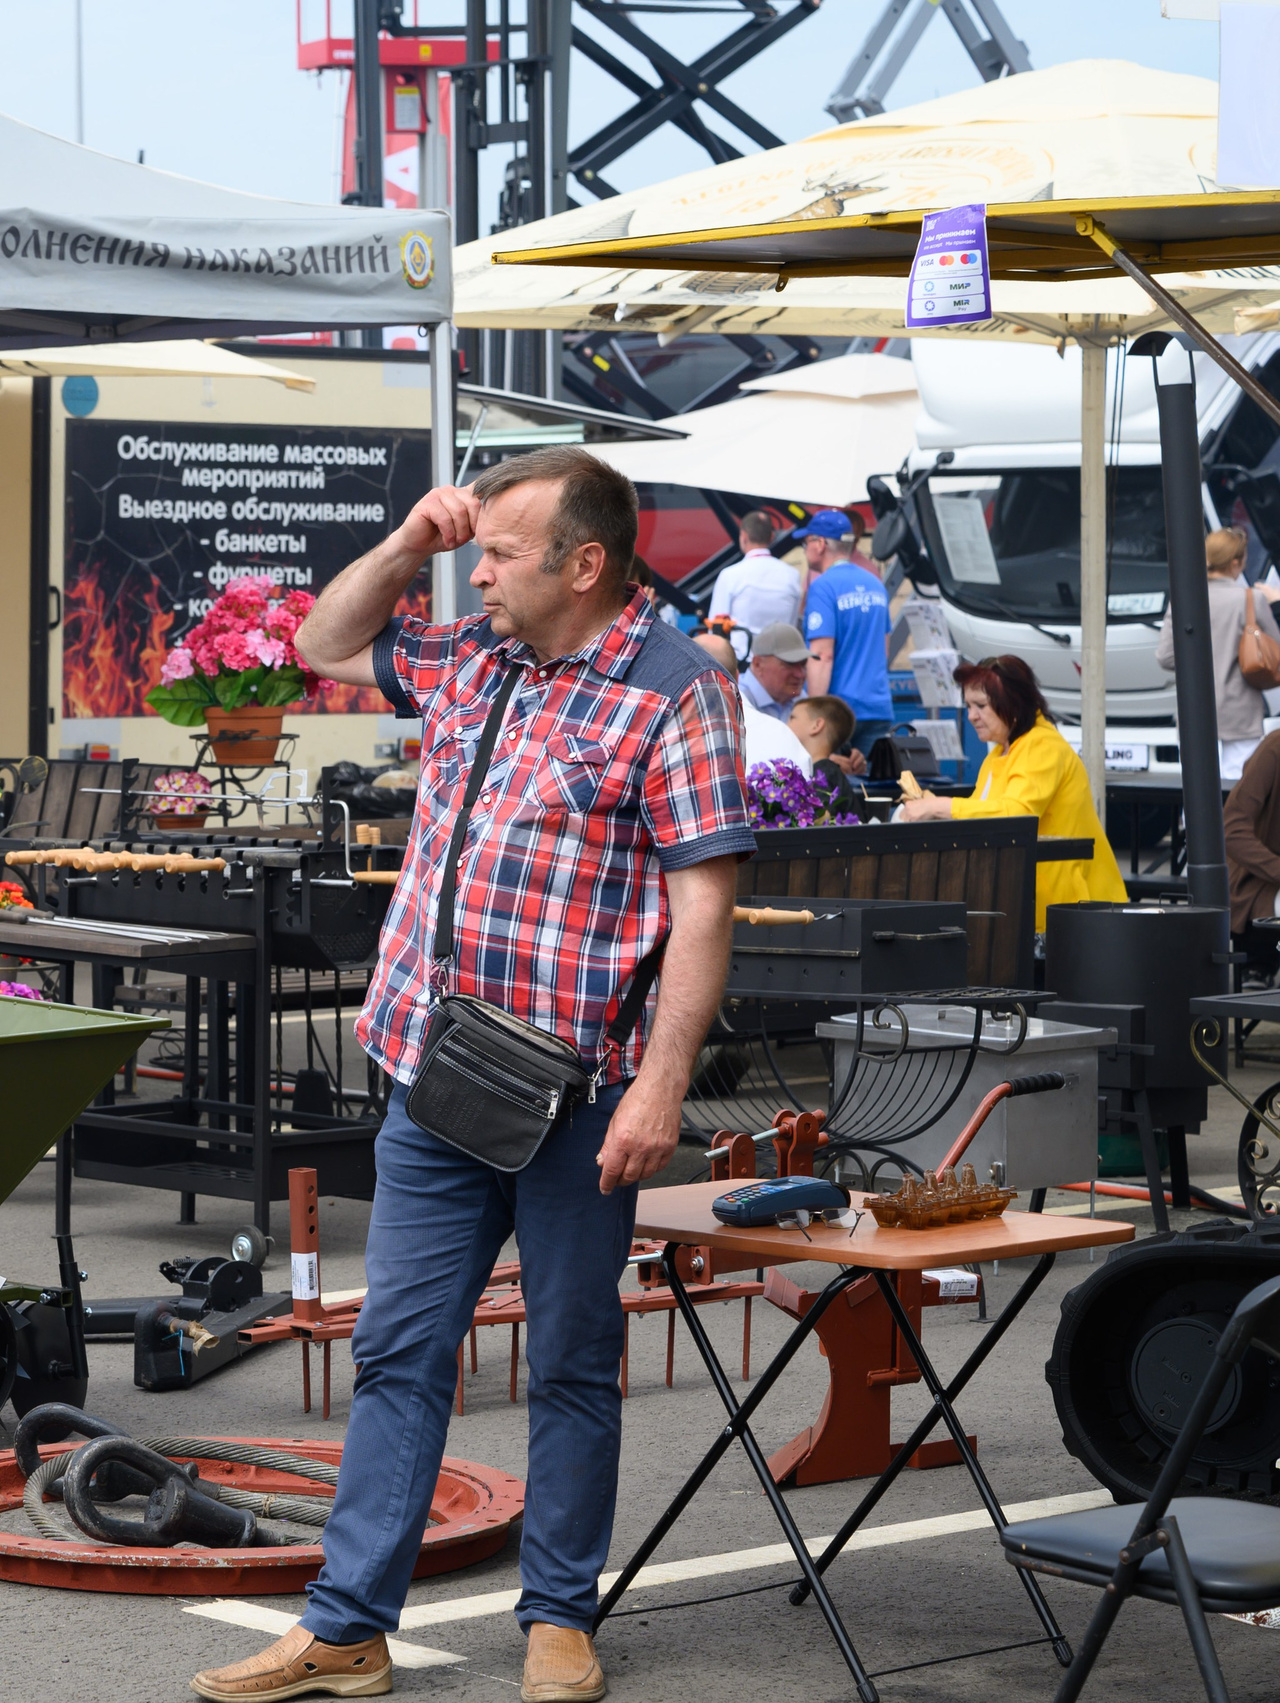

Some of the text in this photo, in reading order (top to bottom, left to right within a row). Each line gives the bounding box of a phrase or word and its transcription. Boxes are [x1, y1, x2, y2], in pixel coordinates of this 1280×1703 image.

[924, 228, 976, 243] Мы принимаем
[180, 234, 391, 277] наказаний
[920, 258, 934, 267] VISA
[949, 282, 971, 291] МИР
[953, 299, 970, 307] MIR
[117, 435, 387, 466] Обслуживание массовых
[181, 466, 325, 495] мероприятий
[118, 494, 386, 527] Выездное обслуживание
[215, 528, 307, 554] банкеты
